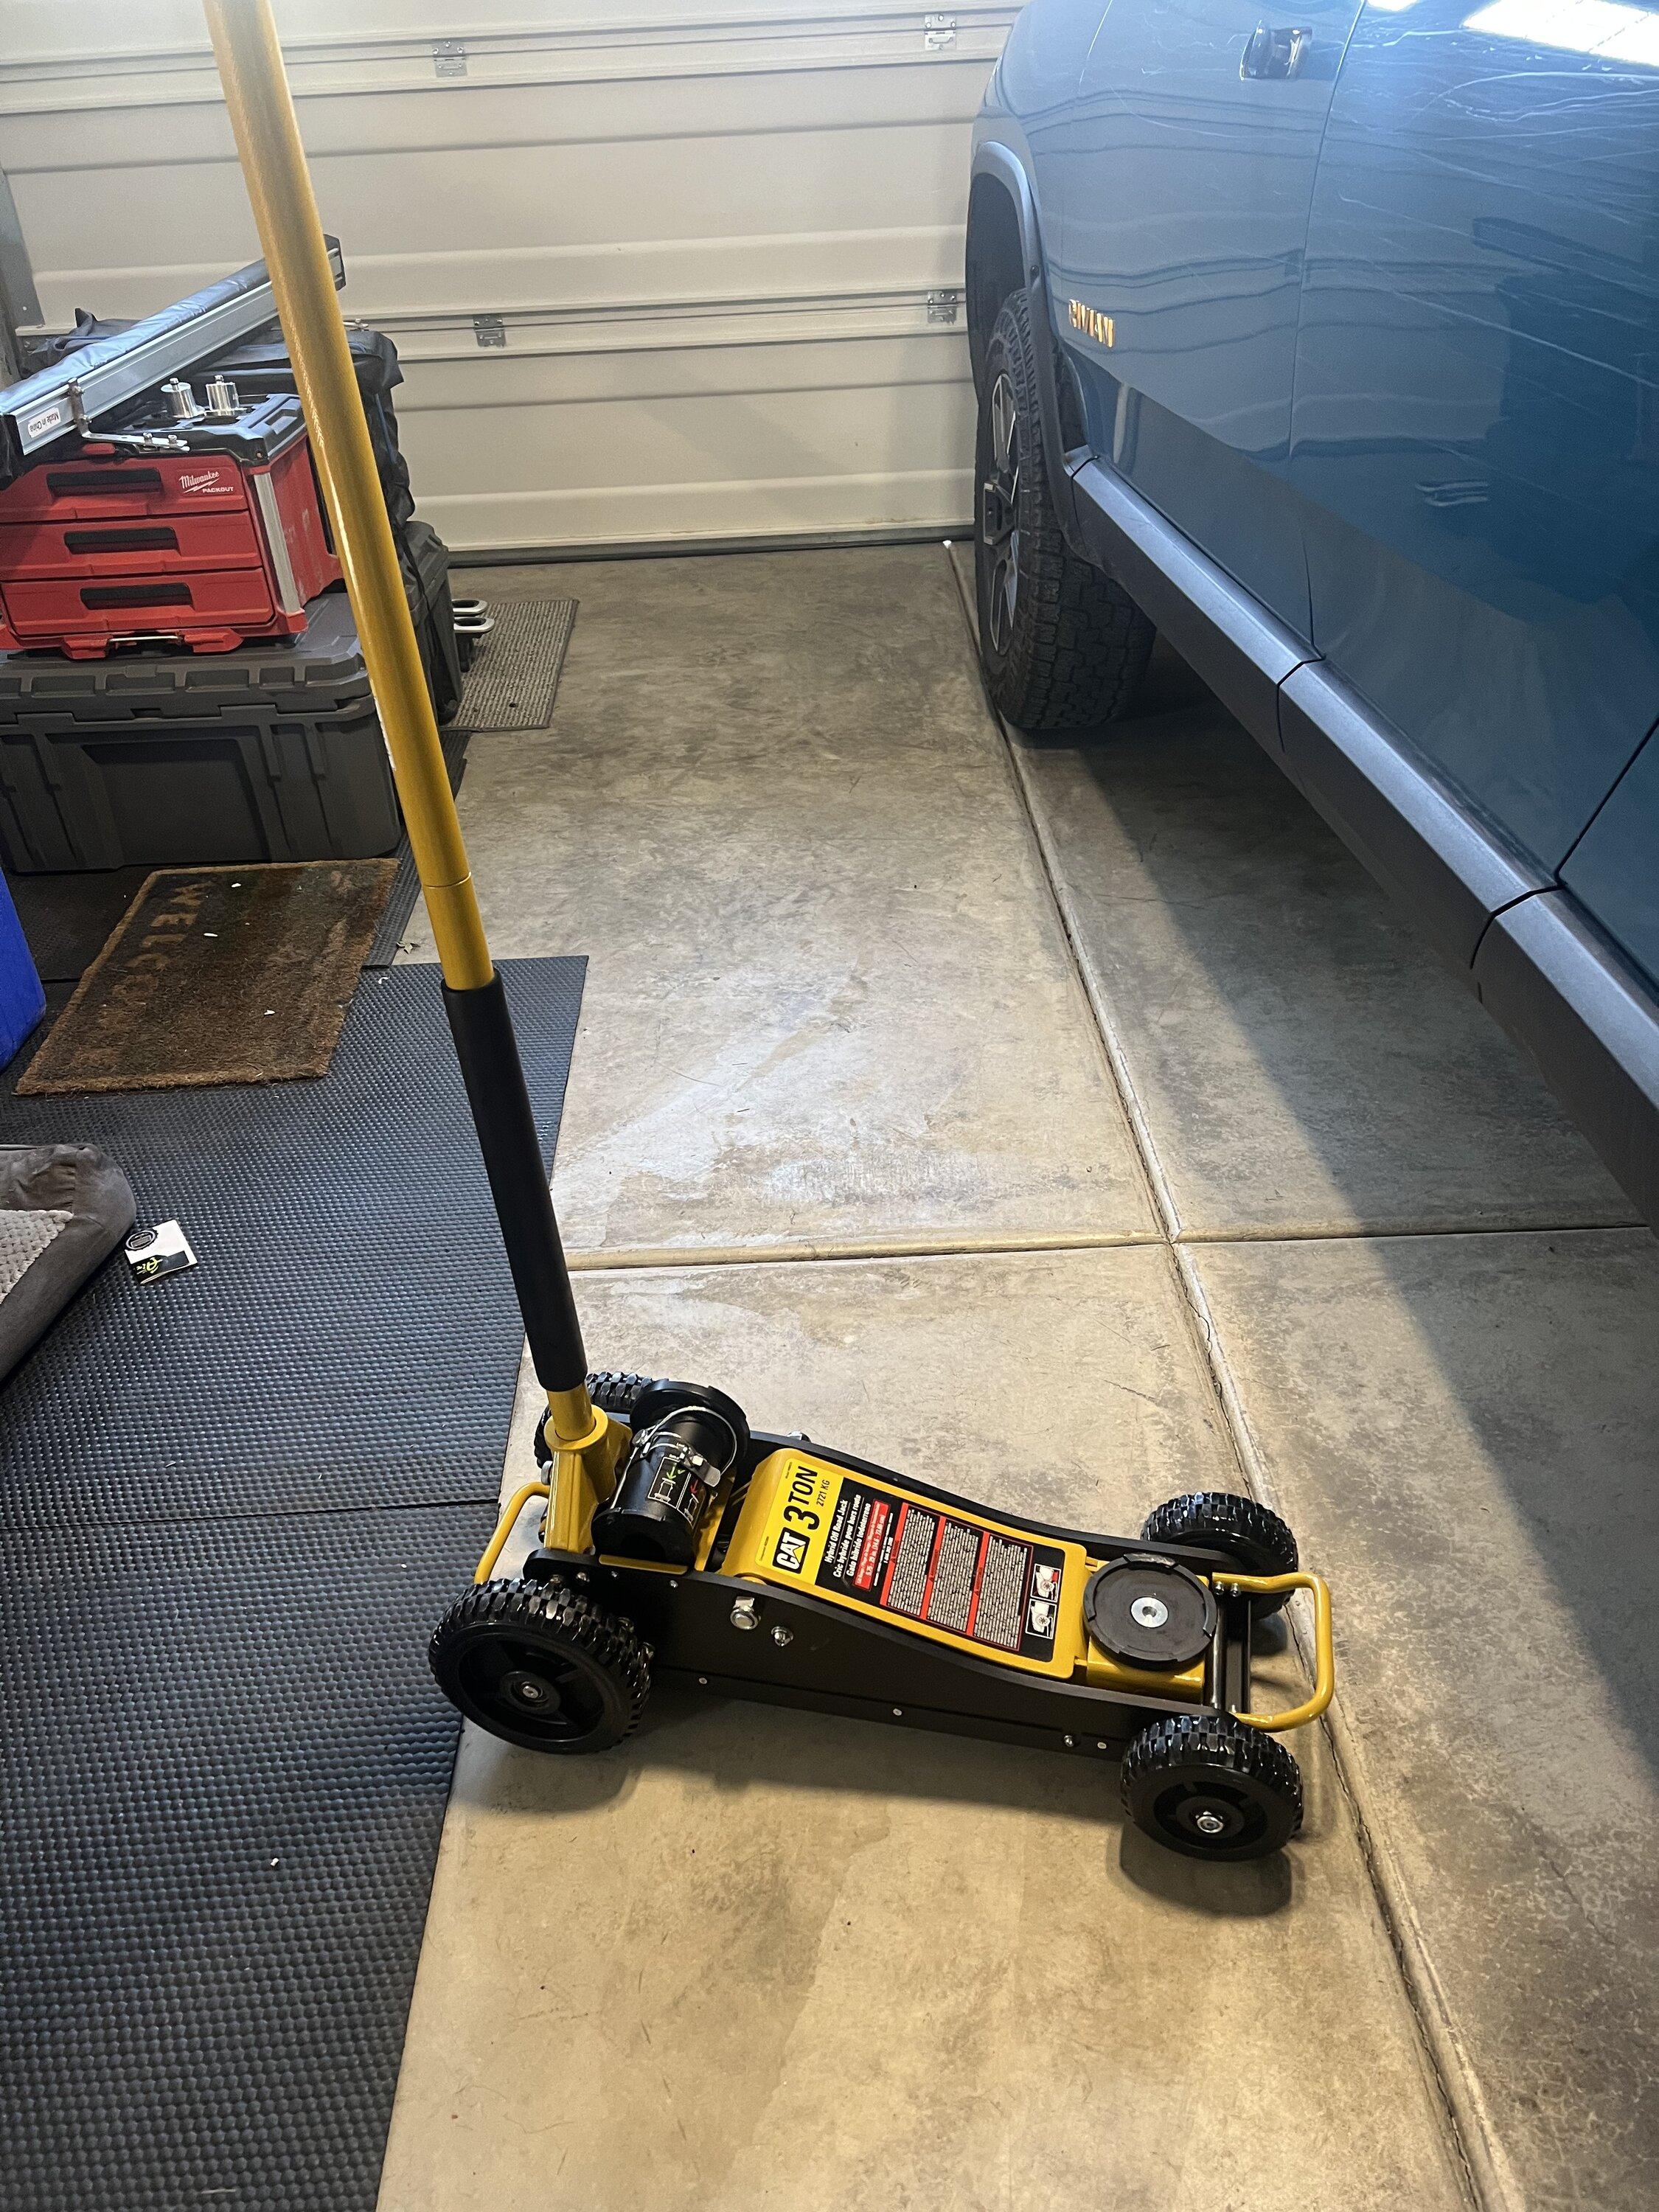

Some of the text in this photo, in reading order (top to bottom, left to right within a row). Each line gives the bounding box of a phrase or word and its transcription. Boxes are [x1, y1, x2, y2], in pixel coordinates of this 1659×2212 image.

[1068, 299, 1115, 348] RIVIAN
[29, 421, 42, 432] China
[46, 412, 59, 424] Made
[178, 470, 220, 489] Milwaukee
[783, 1466, 820, 1531] 3 TON
[816, 1479, 830, 1507] 2721 KG
[776, 1532, 807, 1570] CAT
[824, 1499, 848, 1563] Hybrid Off Road Jack
[833, 1494, 861, 1578] Cric hybride pour hors route
[846, 1560, 857, 1576] Gato
[857, 1503, 871, 1538] todoterreno
